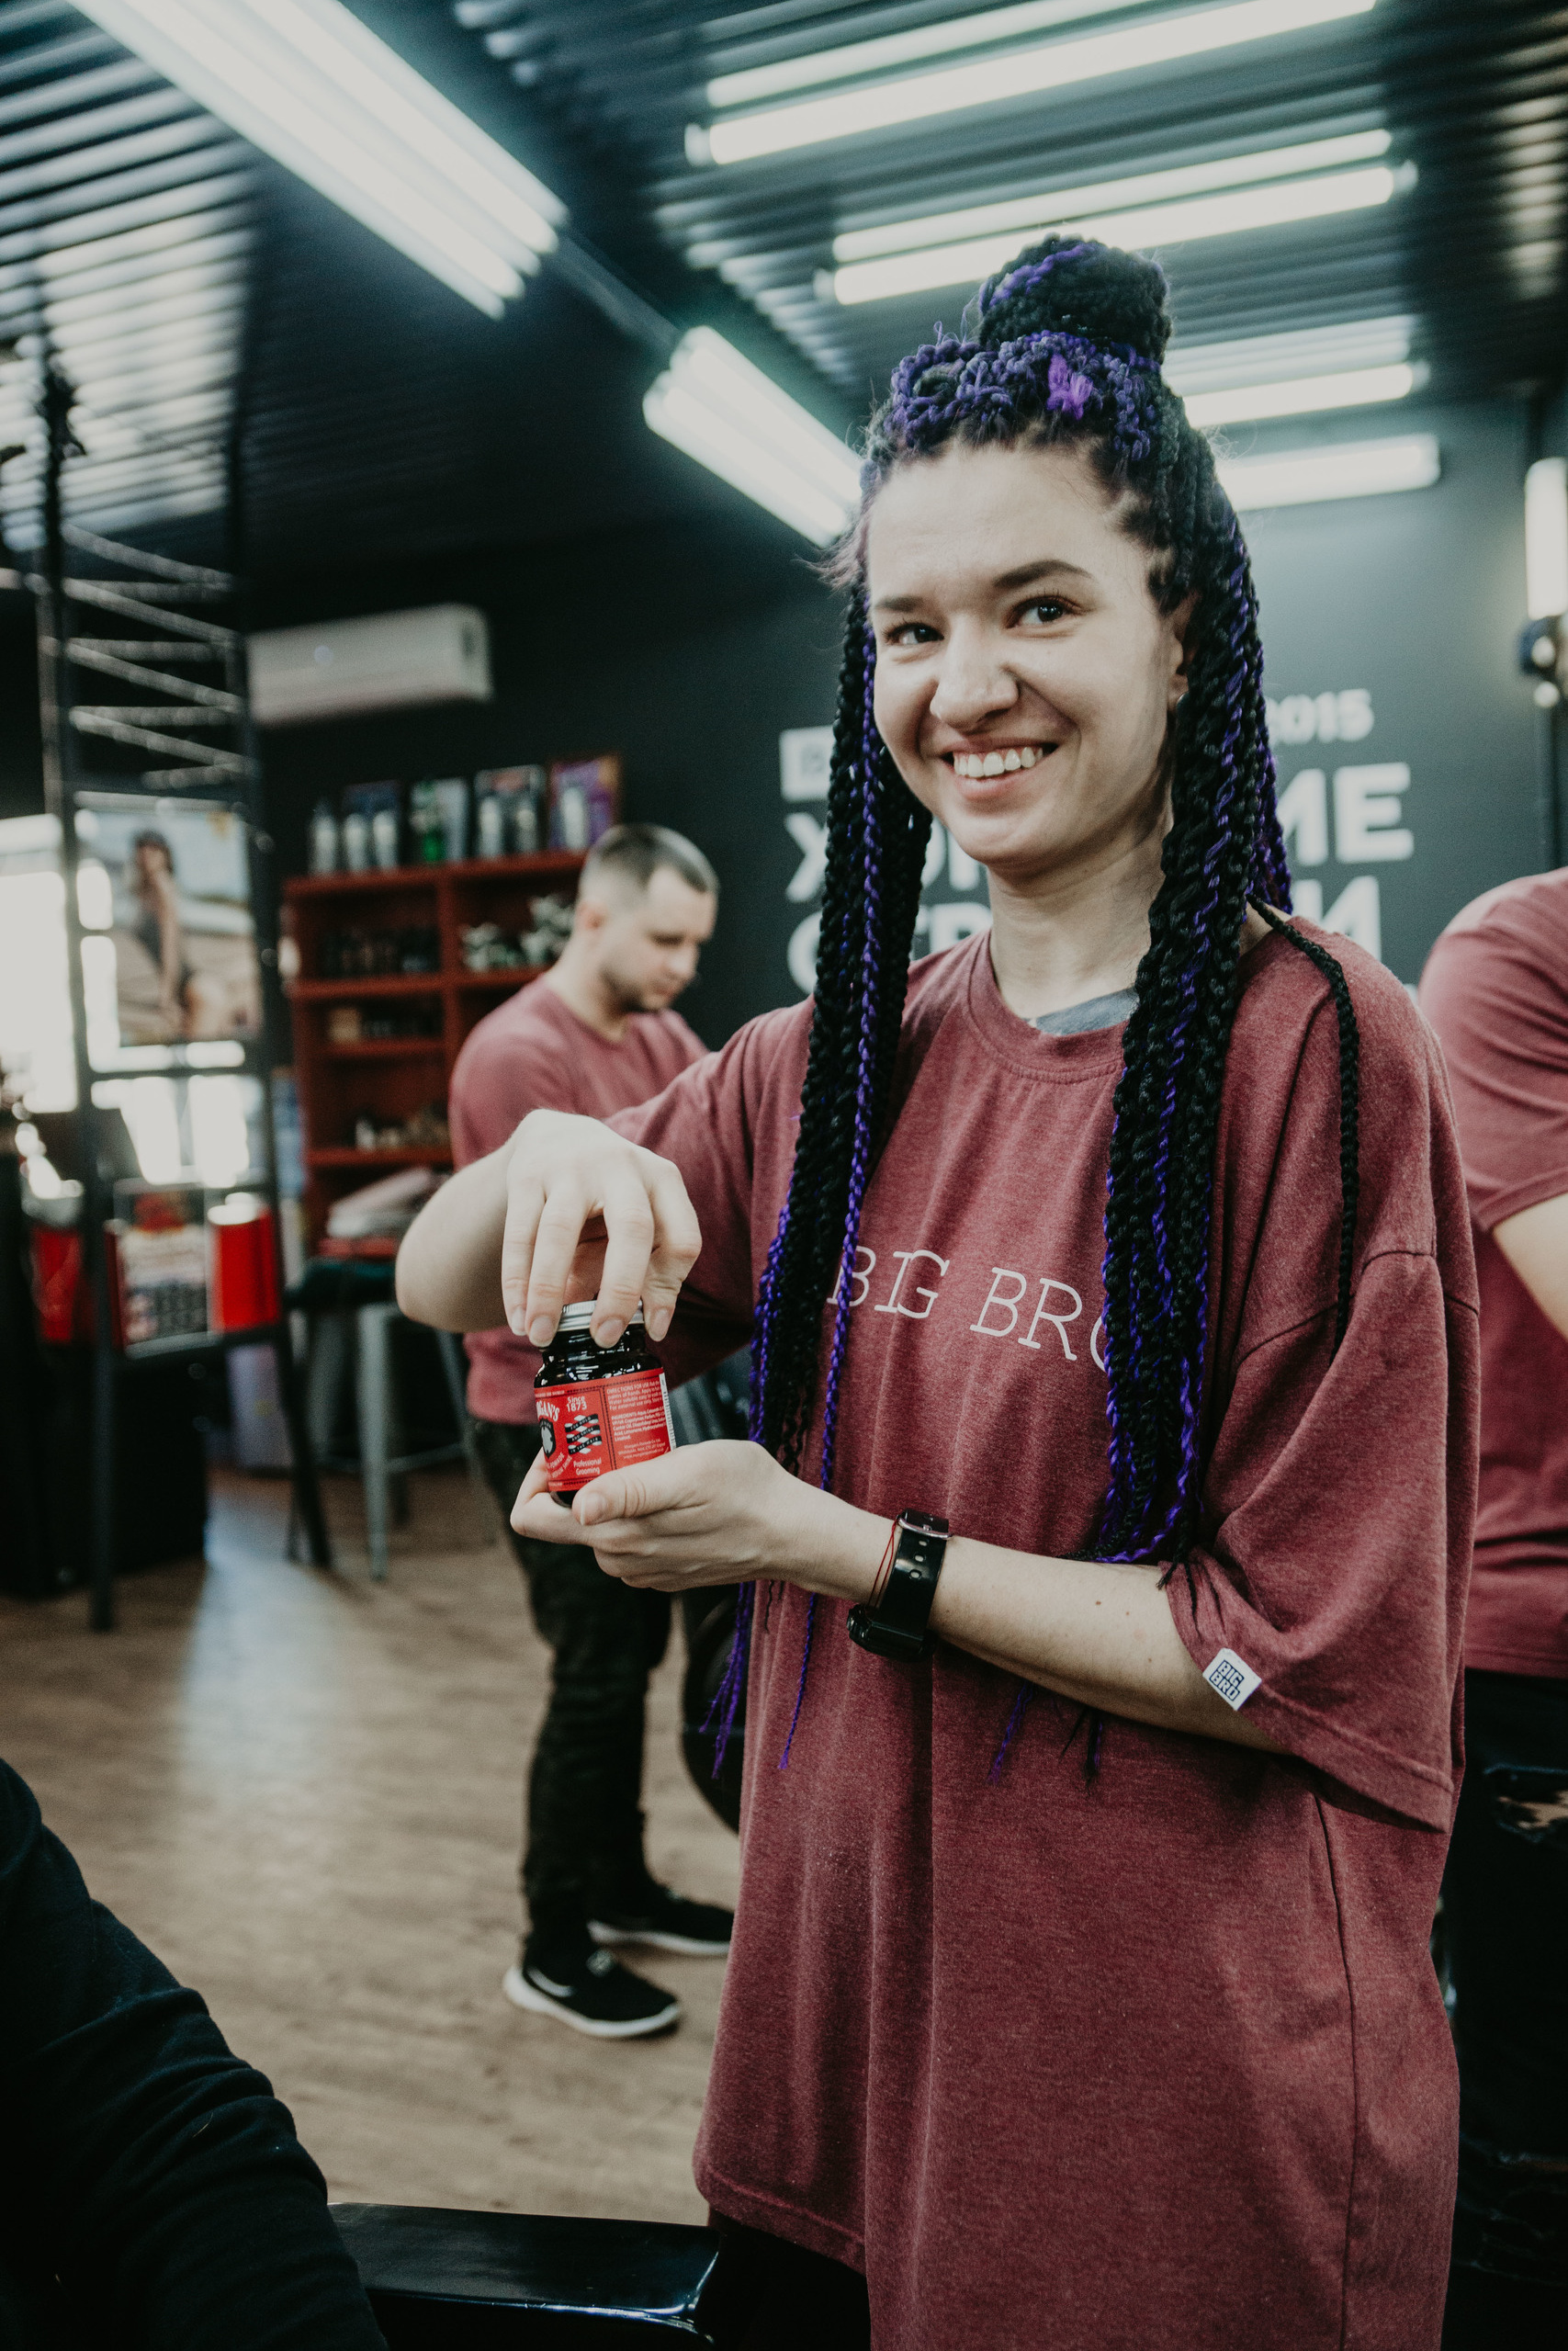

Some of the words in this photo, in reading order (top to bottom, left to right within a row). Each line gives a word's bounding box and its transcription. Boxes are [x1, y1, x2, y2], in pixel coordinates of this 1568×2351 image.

[827, 1245, 951, 1319] BIG
[969, 1266, 1108, 1373] BR
[566, 1400, 588, 1412] 1873
[567, 1396, 586, 1404] Since
[573, 1456, 603, 1468] Professional
[576, 1466, 601, 1475] Grooming
[1217, 1660, 1245, 1688] BIG
[1210, 1670, 1240, 1701] BRO
